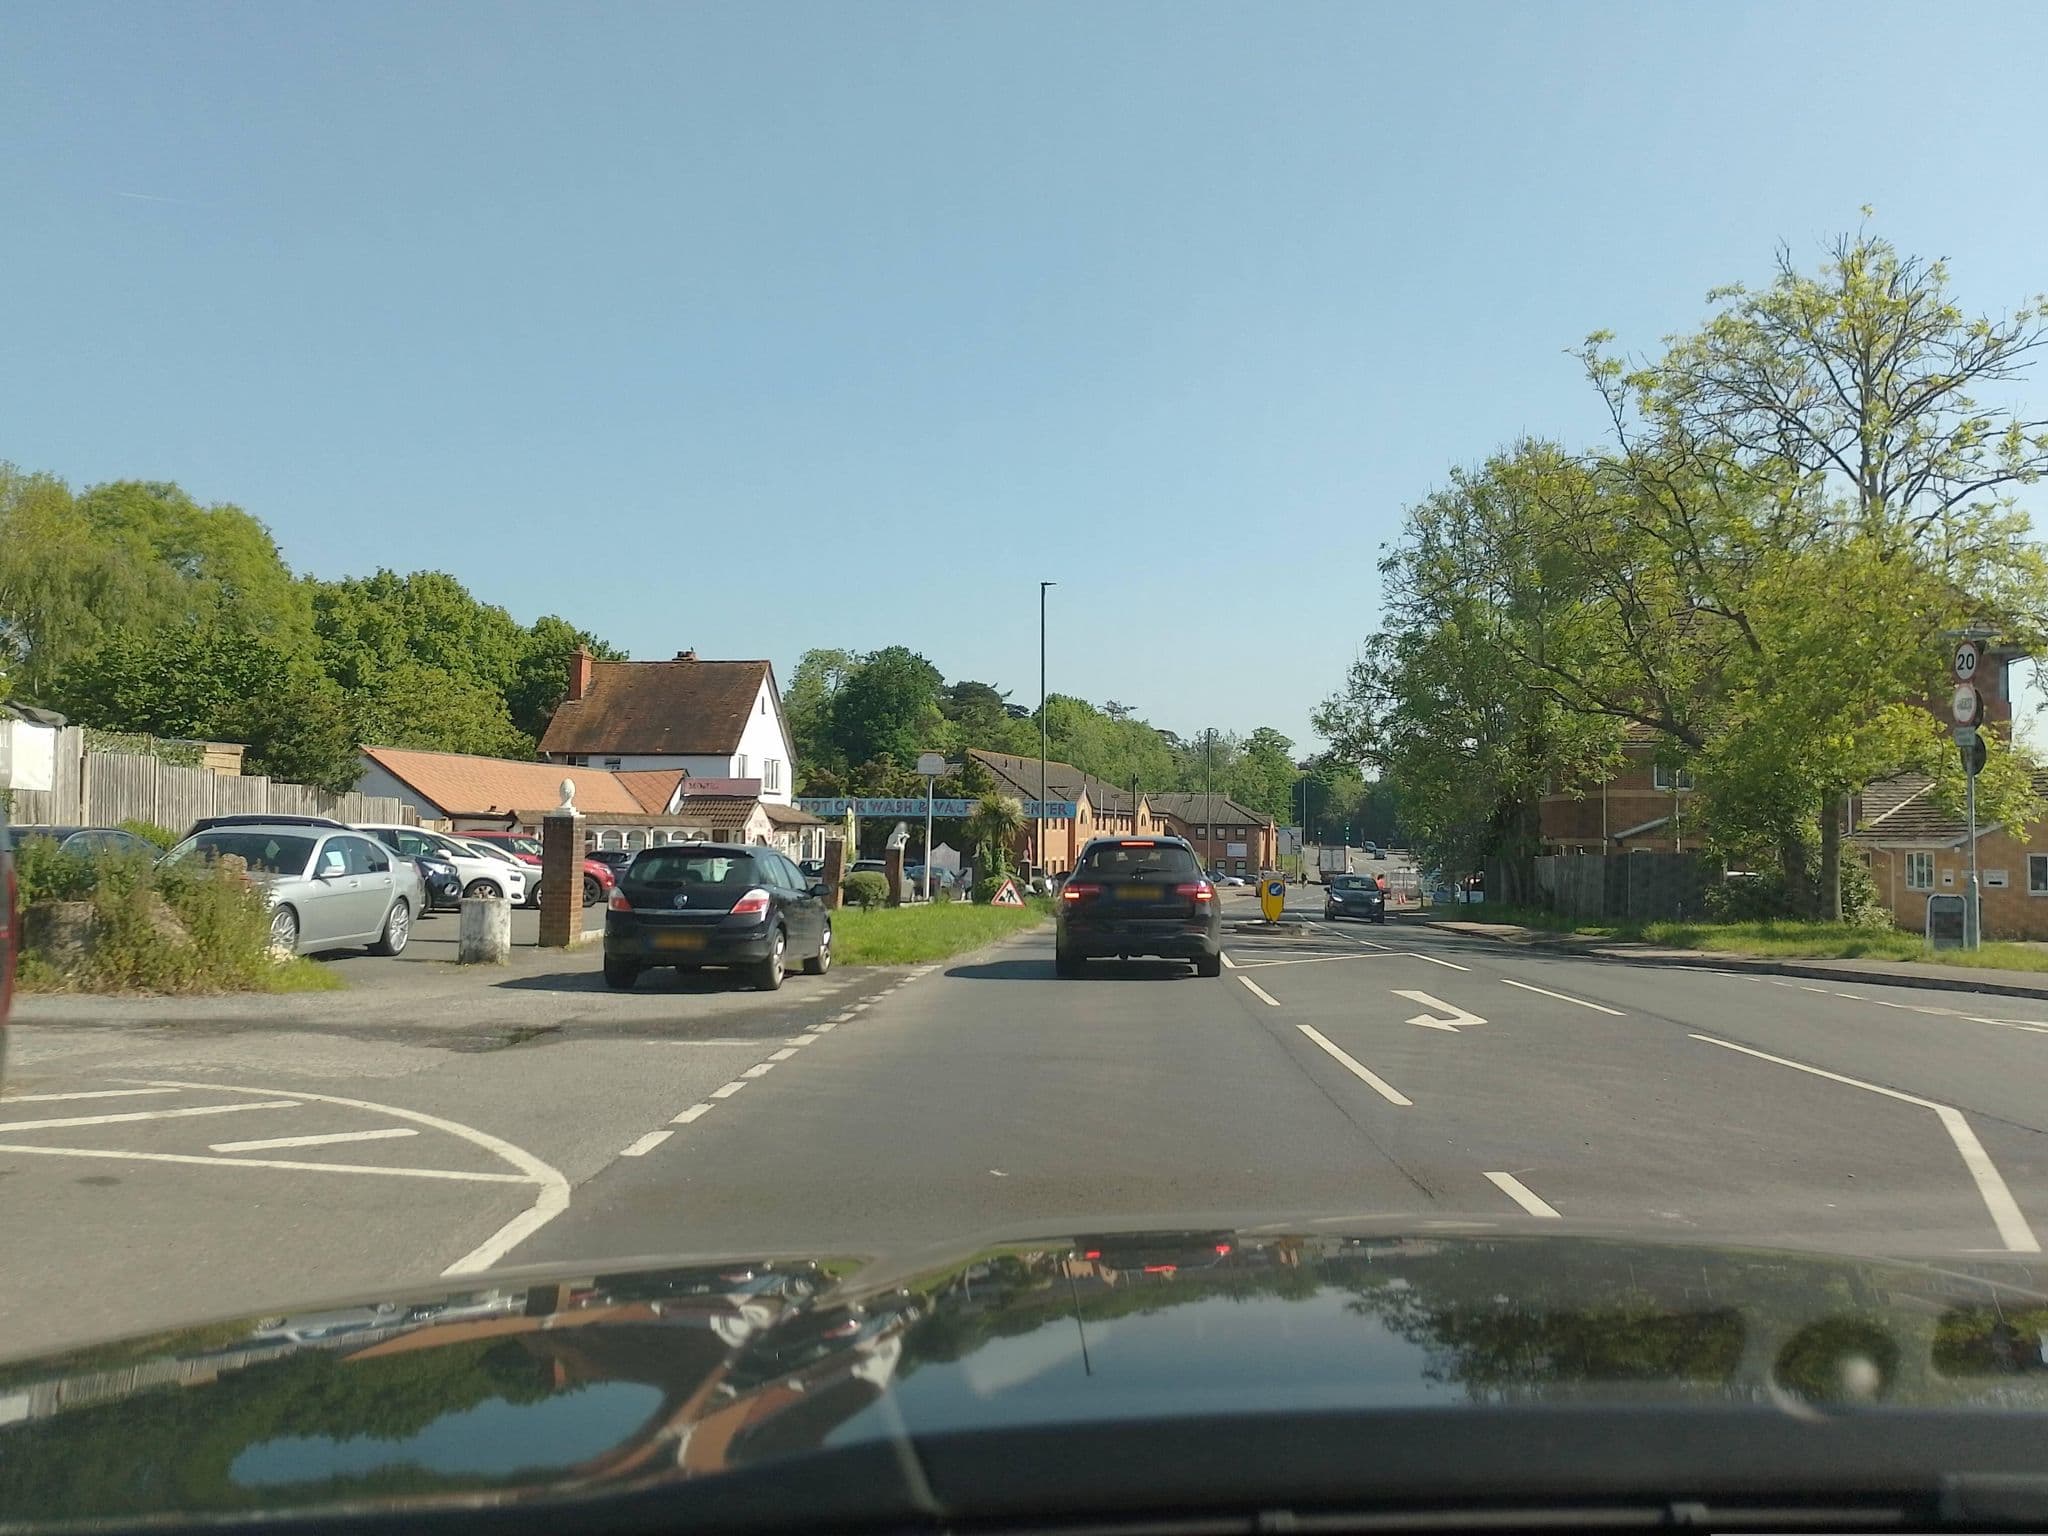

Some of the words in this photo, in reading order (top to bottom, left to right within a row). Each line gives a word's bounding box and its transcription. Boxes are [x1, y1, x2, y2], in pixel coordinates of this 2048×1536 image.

[1957, 653, 1975, 670] 20
[800, 800, 830, 812] HOT
[869, 801, 913, 813] WASH
